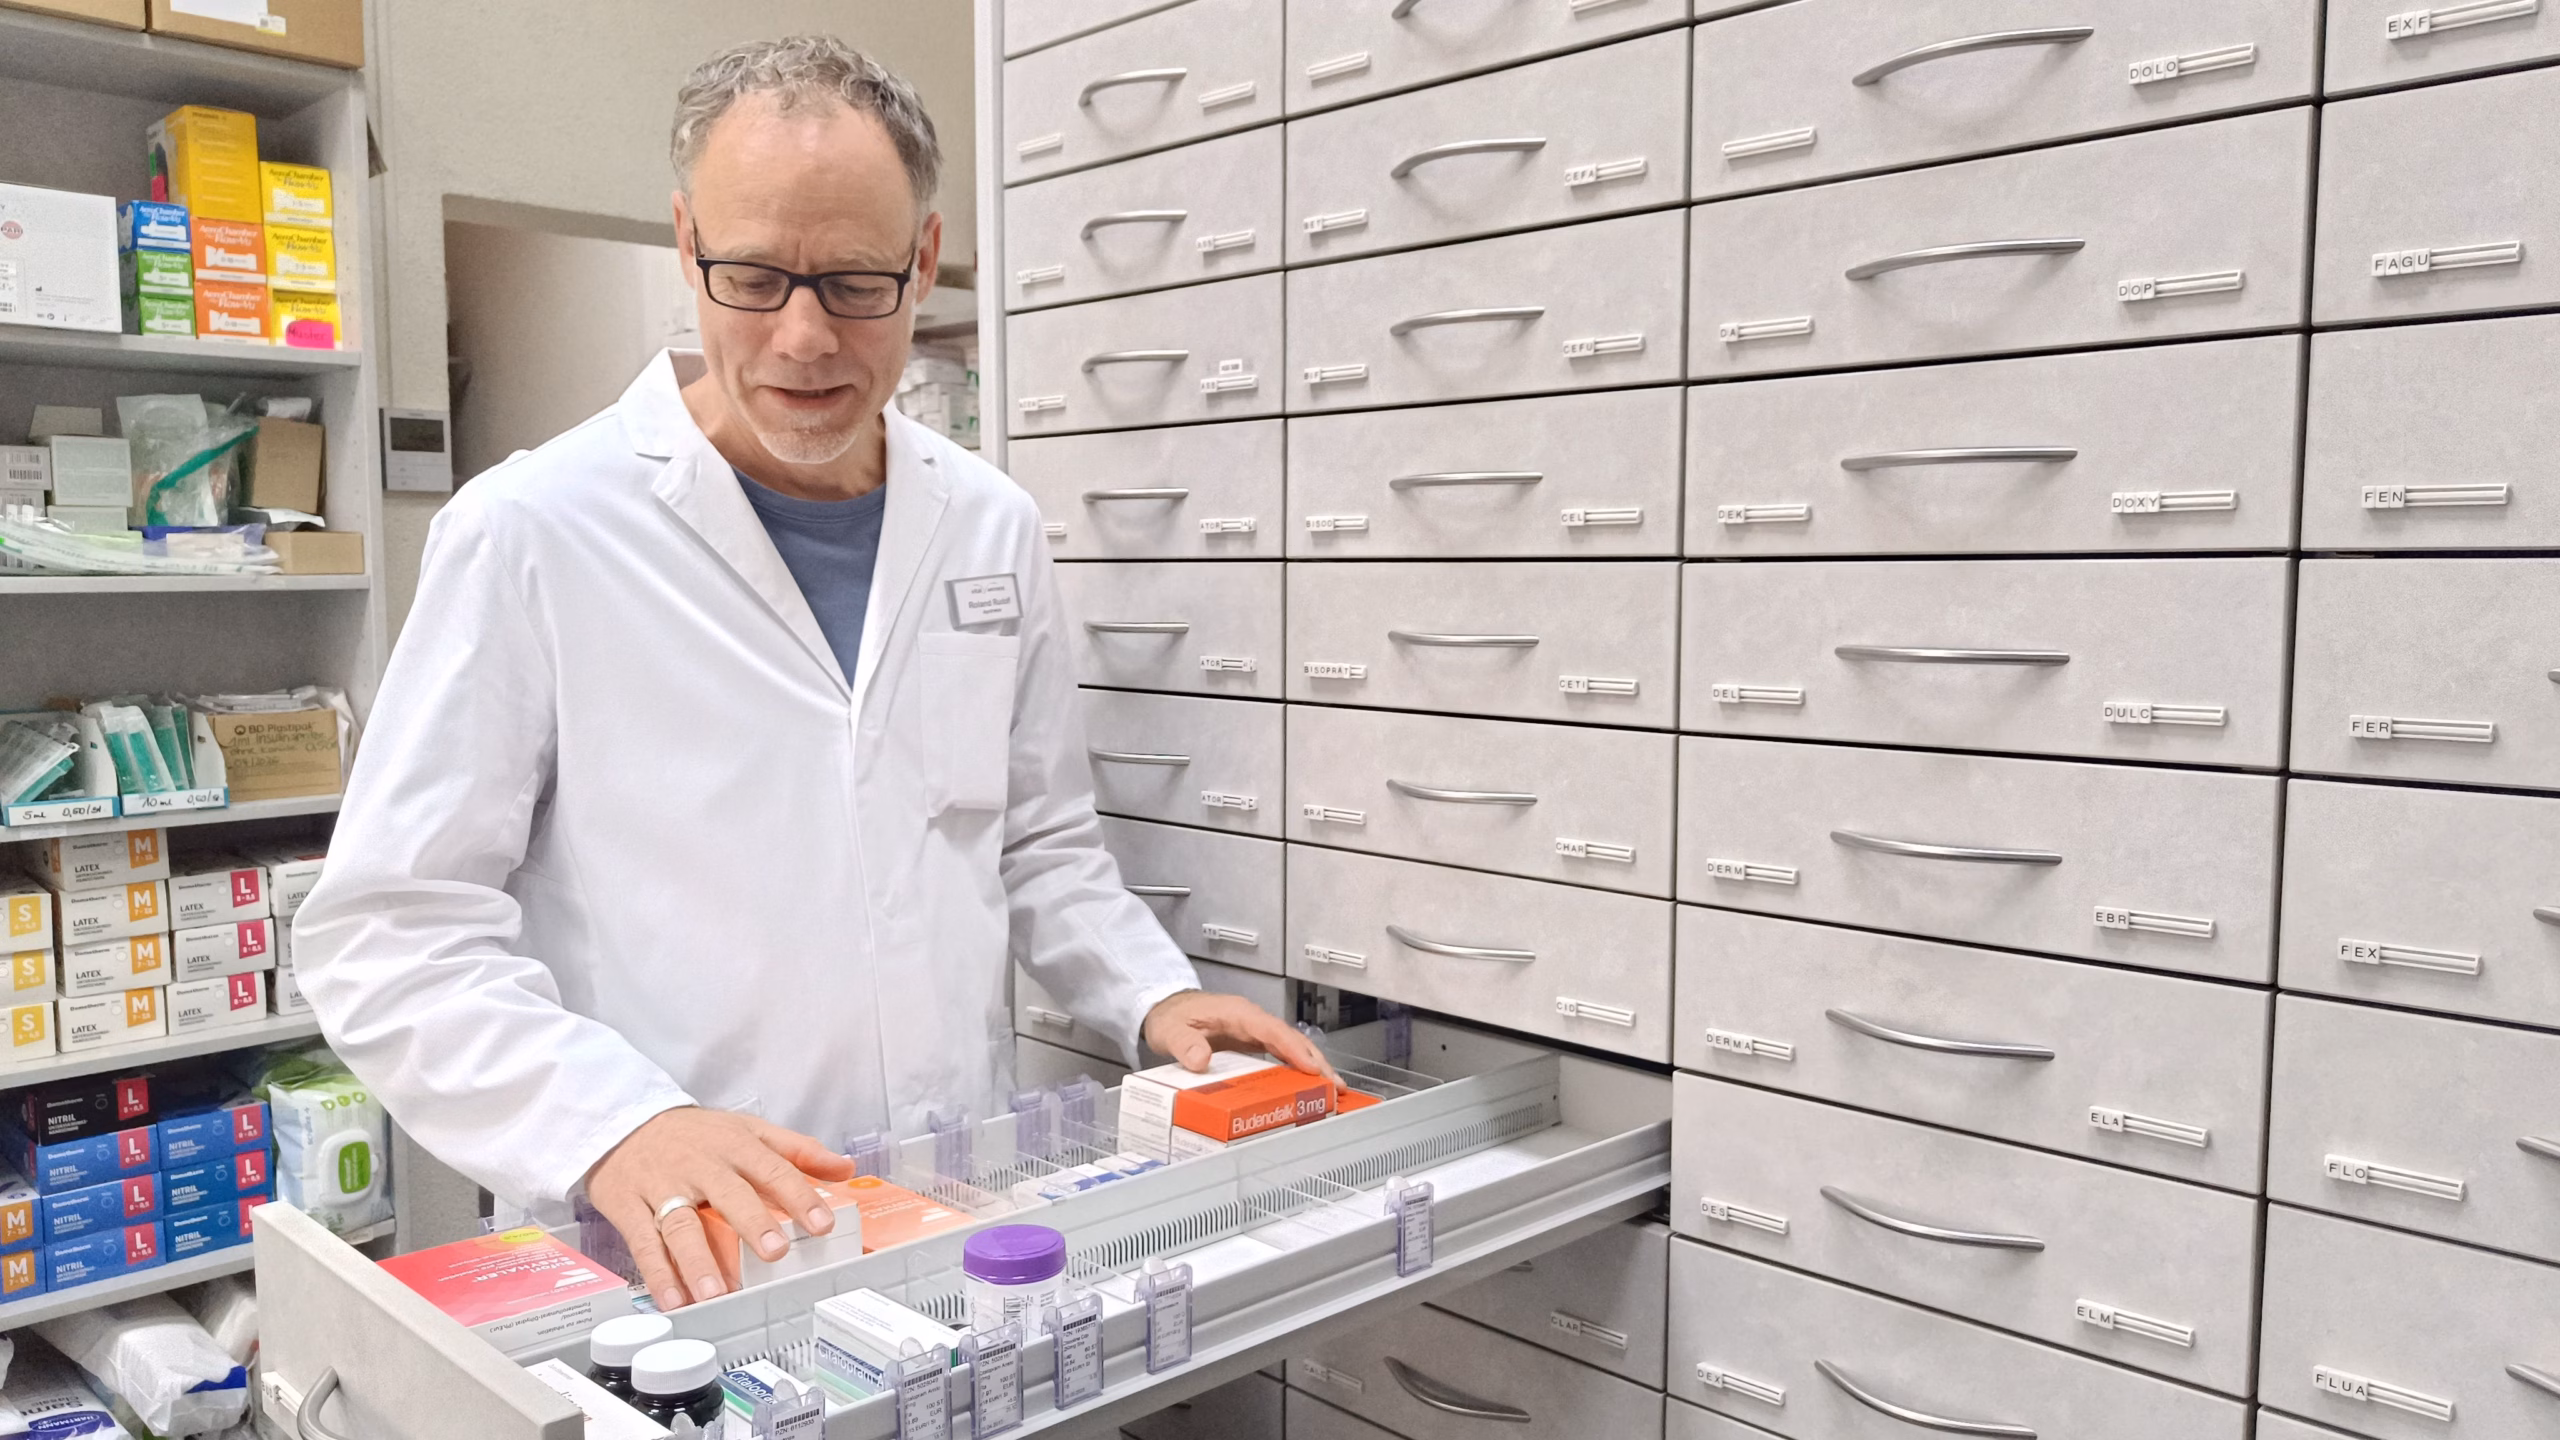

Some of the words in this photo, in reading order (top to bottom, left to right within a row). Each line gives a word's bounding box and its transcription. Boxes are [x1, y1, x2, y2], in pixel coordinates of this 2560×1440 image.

[2387, 16, 2428, 33] EXF
[2129, 61, 2177, 80] DOLO
[1564, 169, 1596, 183] CEFA
[2374, 254, 2429, 270] FAGU
[2118, 283, 2152, 297] DOP
[1719, 327, 1737, 338] DA
[1563, 342, 1593, 354] CEFU
[2112, 497, 2158, 509] DOXY
[2364, 491, 2403, 503] FEN
[1561, 513, 1583, 523] CEL
[1718, 509, 1743, 520] DEK
[1559, 680, 1586, 689] CETI
[1713, 688, 1737, 699] DEL
[2104, 706, 2150, 720] DULC
[248, 724, 265, 734] BD
[267, 722, 313, 733] Plastipak
[2351, 721, 2390, 733] FER
[1201, 795, 1222, 804] ATOR
[1303, 808, 1322, 817] BRA
[134, 836, 152, 854] M
[1555, 841, 1585, 854] CHAR
[74, 863, 100, 873] LATEX
[1707, 862, 1743, 876] DERM
[240, 878, 251, 893] L
[133, 889, 151, 908] M
[18, 904, 32, 922] S
[179, 902, 204, 913] LATEX
[73, 917, 98, 927] LATEX
[2095, 911, 2127, 925] EBR
[246, 928, 258, 945] L
[137, 941, 155, 960] M
[1304, 947, 1328, 960] BRON
[2340, 944, 2377, 959] FEX
[187, 955, 210, 964] LATEX
[22, 958, 36, 977] S
[75, 970, 101, 980] LATEX
[236, 980, 249, 997] L
[132, 994, 150, 1013] M
[1556, 1001, 1576, 1013] CID
[178, 1007, 202, 1018] LATEX
[21, 1013, 35, 1032] S
[71, 1023, 97, 1034] LATEX
[1706, 1033, 1751, 1051] DERMA
[127, 1088, 139, 1105] L
[47, 1113, 76, 1125] NITRIL
[242, 1113, 254, 1131] L
[1231, 1101, 1294, 1134] Budenofalk
[2090, 1112, 2120, 1127] ELA
[128, 1137, 141, 1155] L
[168, 1139, 196, 1151] NITRIL
[49, 1165, 78, 1177] NITRIL
[245, 1158, 257, 1176] L
[2329, 1162, 2367, 1179] FLO
[133, 1185, 146, 1203] L
[171, 1184, 198, 1197] NITRIL
[1701, 1203, 1726, 1218] DES
[6, 1209, 26, 1230] M
[53, 1212, 82, 1226] NITRIL
[135, 1231, 148, 1249] L
[175, 1230, 201, 1244] NITRIL
[8, 1258, 27, 1278] M
[56, 1260, 85, 1273] NITRIL
[472, 1256, 571, 1283] EASYHALER
[2076, 1305, 2111, 1325] ELM
[1550, 1314, 1580, 1332] CLAR
[817, 1342, 878, 1384] Citalopram
[1697, 1368, 1722, 1384] DEX
[728, 1370, 778, 1405] Citalopra
[2315, 1372, 2366, 1397] FLUA
[929, 1407, 943, 1417] EUR
[38, 1415, 94, 1430] HARTMANN
